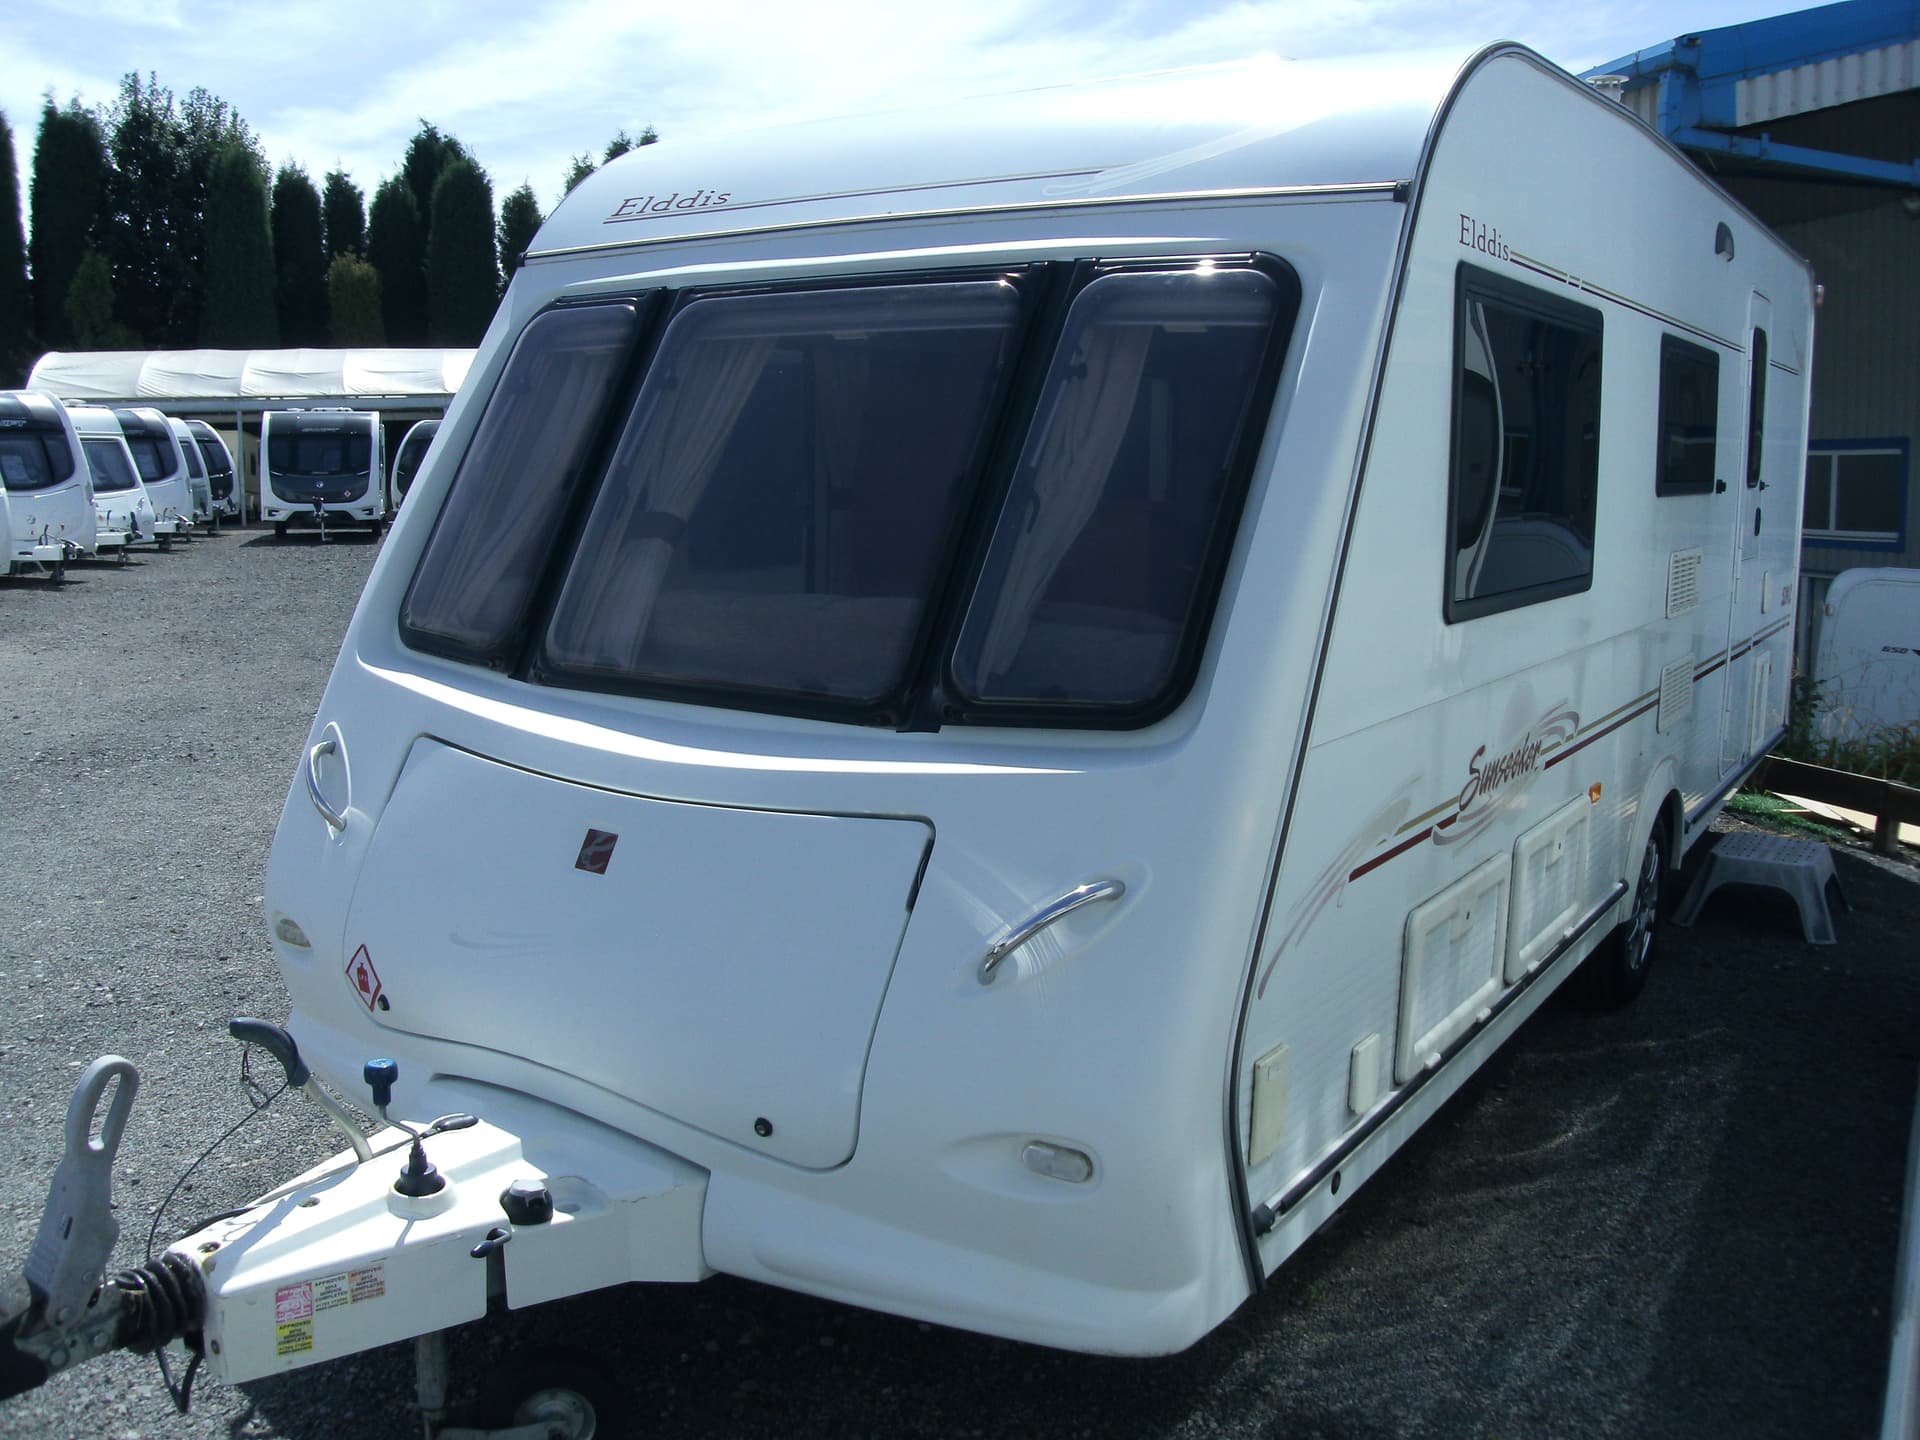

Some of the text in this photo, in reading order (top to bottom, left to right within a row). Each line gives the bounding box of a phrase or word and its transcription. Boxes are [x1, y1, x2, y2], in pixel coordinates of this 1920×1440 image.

[611, 190, 731, 217] Elddis
[1459, 213, 1509, 262] Elddis
[1459, 731, 1542, 812] Sunseeker
